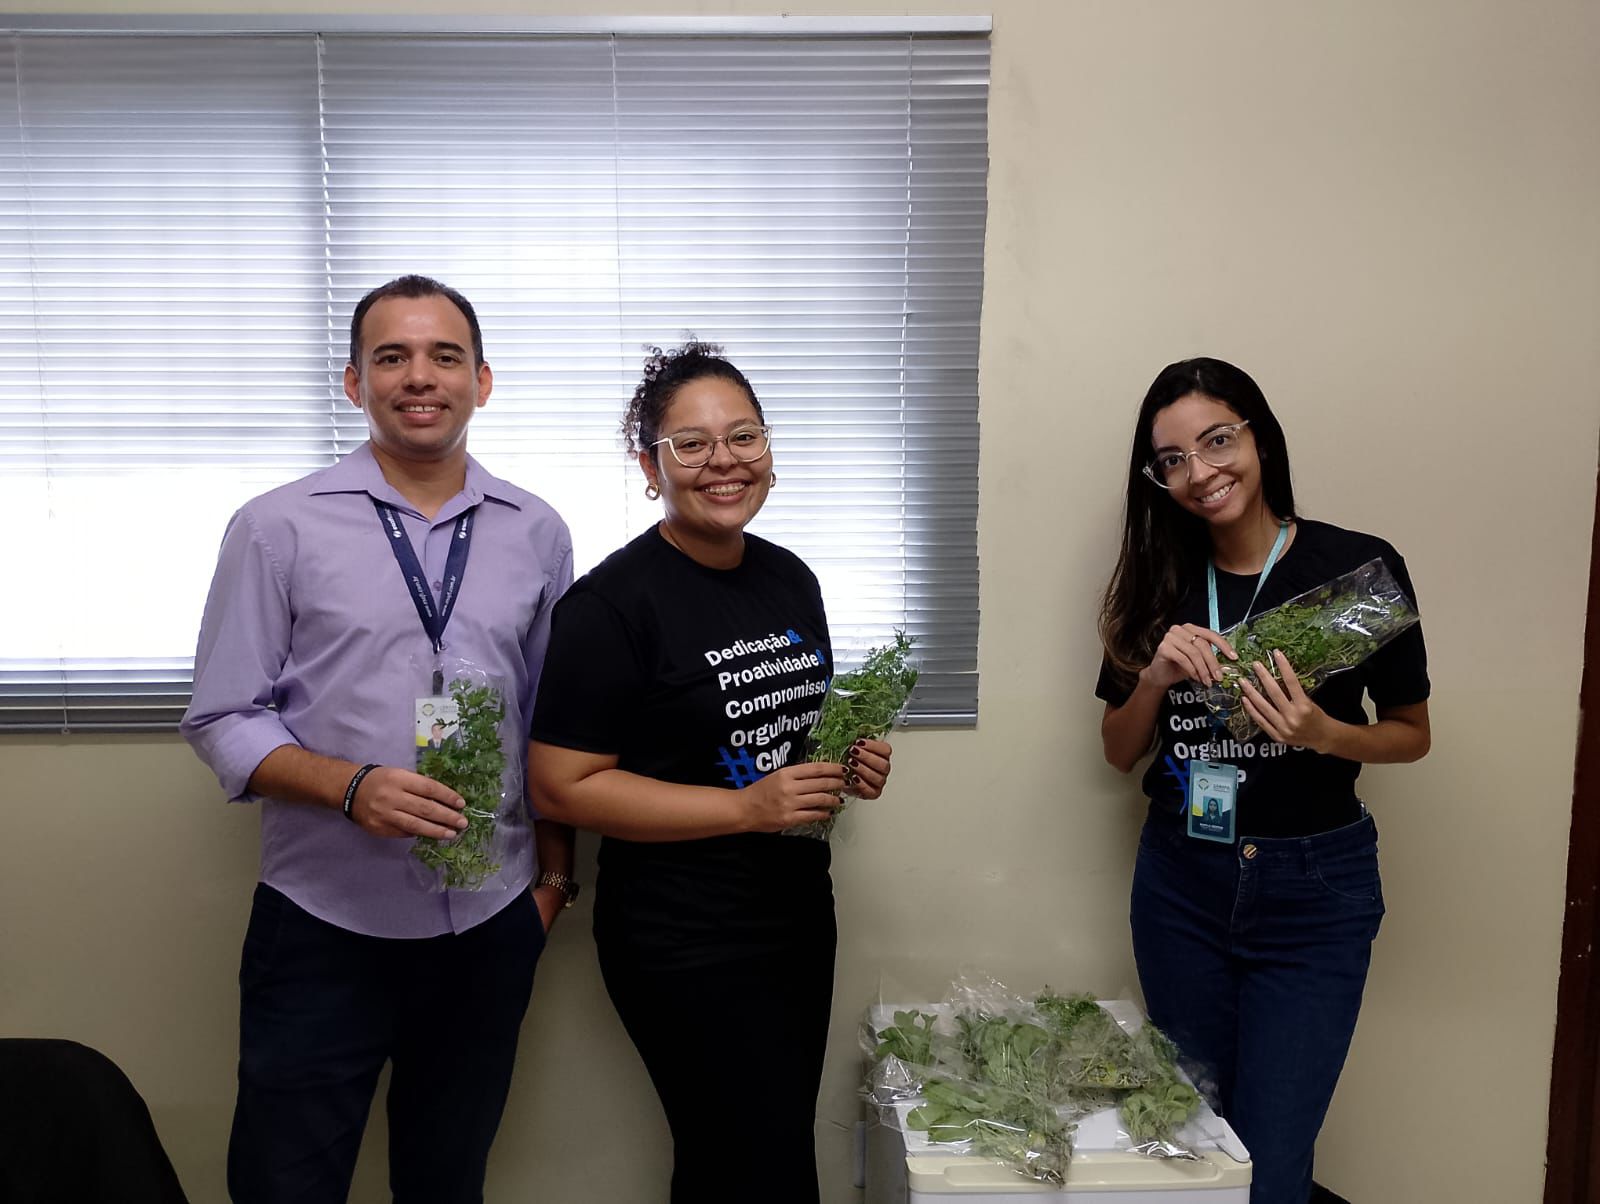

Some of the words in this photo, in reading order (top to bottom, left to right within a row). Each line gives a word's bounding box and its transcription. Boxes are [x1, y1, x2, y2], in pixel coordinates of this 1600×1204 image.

[704, 629, 802, 667] Dedicação&
[718, 649, 825, 691] Proatividade&
[730, 714, 799, 748] Orgulho
